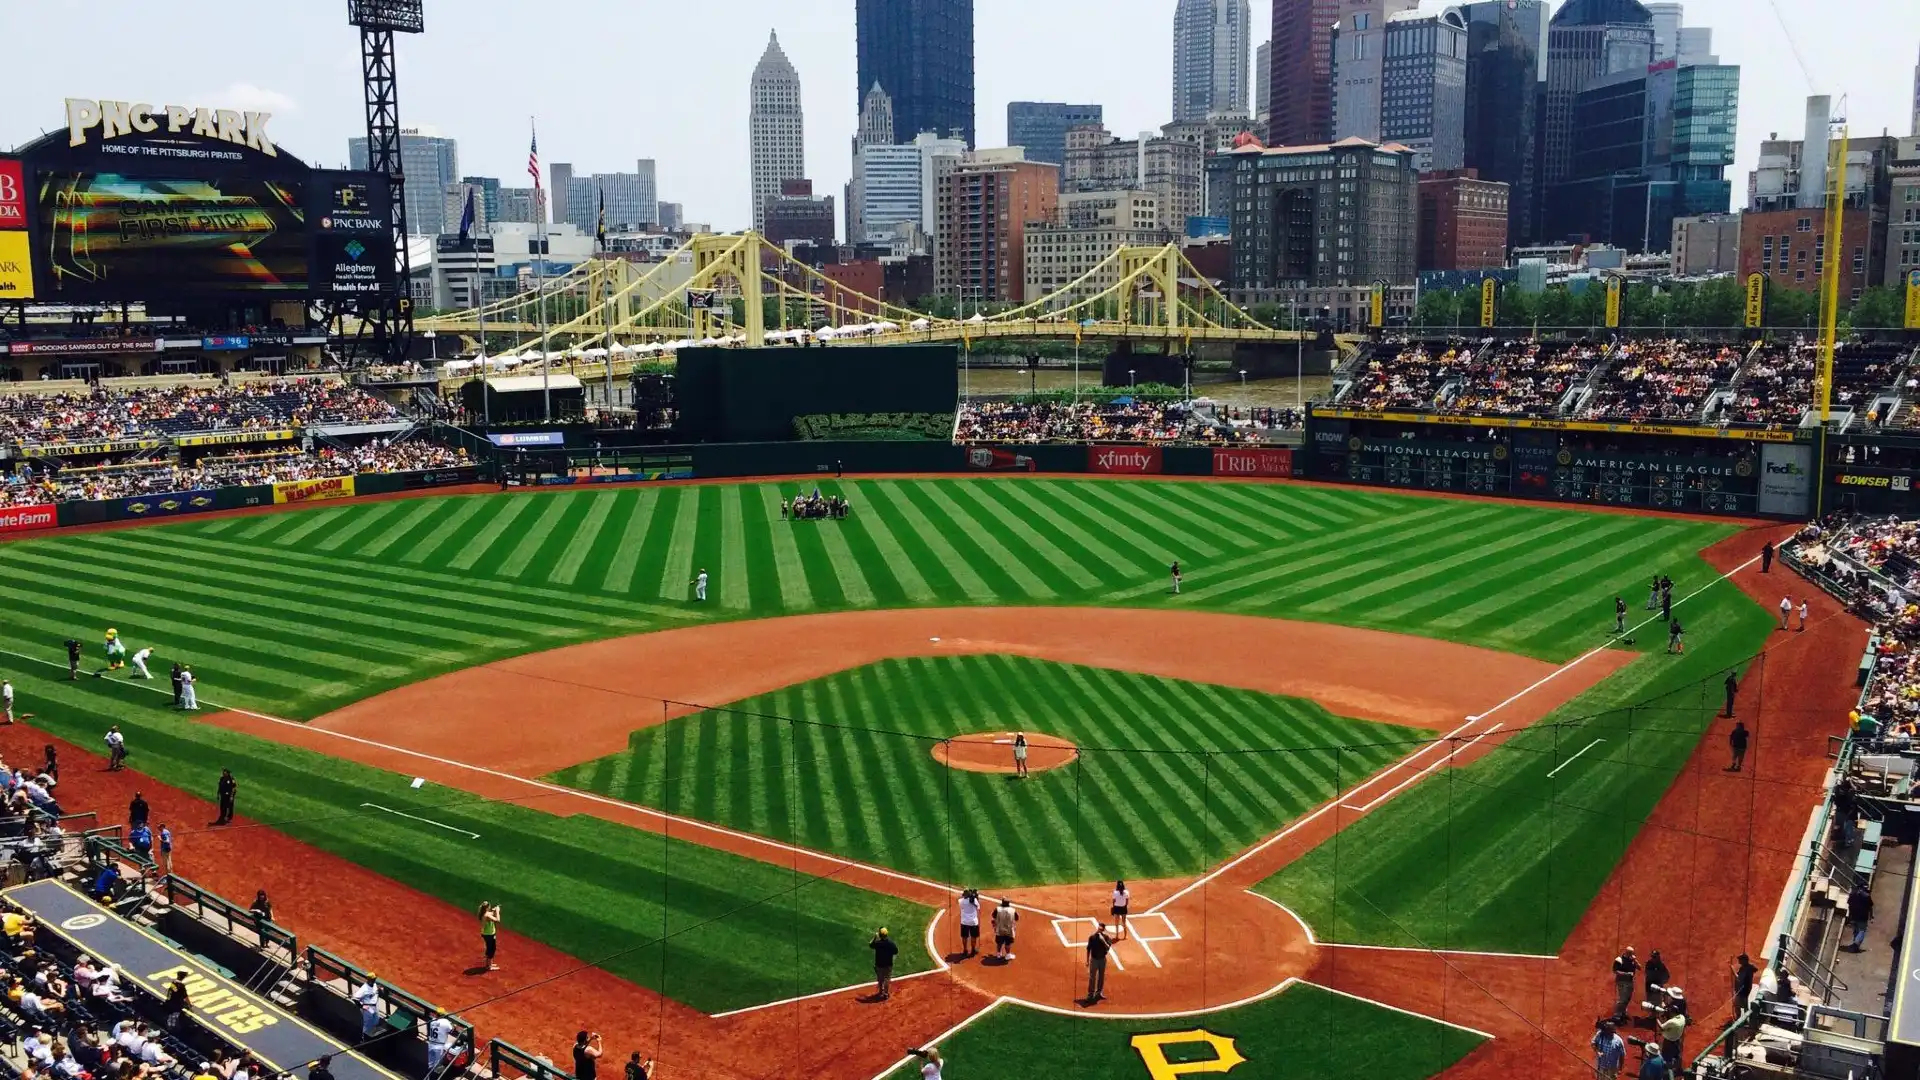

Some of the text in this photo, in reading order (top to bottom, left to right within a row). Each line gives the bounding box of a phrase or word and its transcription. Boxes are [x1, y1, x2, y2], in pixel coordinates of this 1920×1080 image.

[65, 97, 278, 158] PNC PARK
[102, 144, 243, 161] HOME OF THE PITTSBURGH PIRATES
[118, 212, 249, 243] FIRST PITCH
[335, 263, 376, 275] Allegheny
[332, 282, 380, 292] Health for All
[1751, 277, 1760, 301] Health
[33, 344, 67, 352] KNOCKING
[96, 343, 111, 351] OUT
[1632, 425, 1643, 433] All
[1744, 431, 1789, 441] All for Health
[216, 435, 244, 444] LIGHT
[246, 432, 268, 442] BEER
[514, 435, 550, 443] LUMBER
[44, 441, 140, 457] IRON CITY BEER
[1363, 444, 1431, 456] NATIONAL
[1436, 449, 1491, 460] LEAGUE
[1098, 451, 1151, 470] xfinity
[1214, 453, 1257, 472] TRIB
[1574, 458, 1732, 476] AMERICAN LEAGUE
[1766, 461, 1804, 475] FedEx
[1840, 474, 1889, 487] BOWSER
[1724, 503, 1737, 511] OAK
[1130, 1027, 1248, 1080] P
